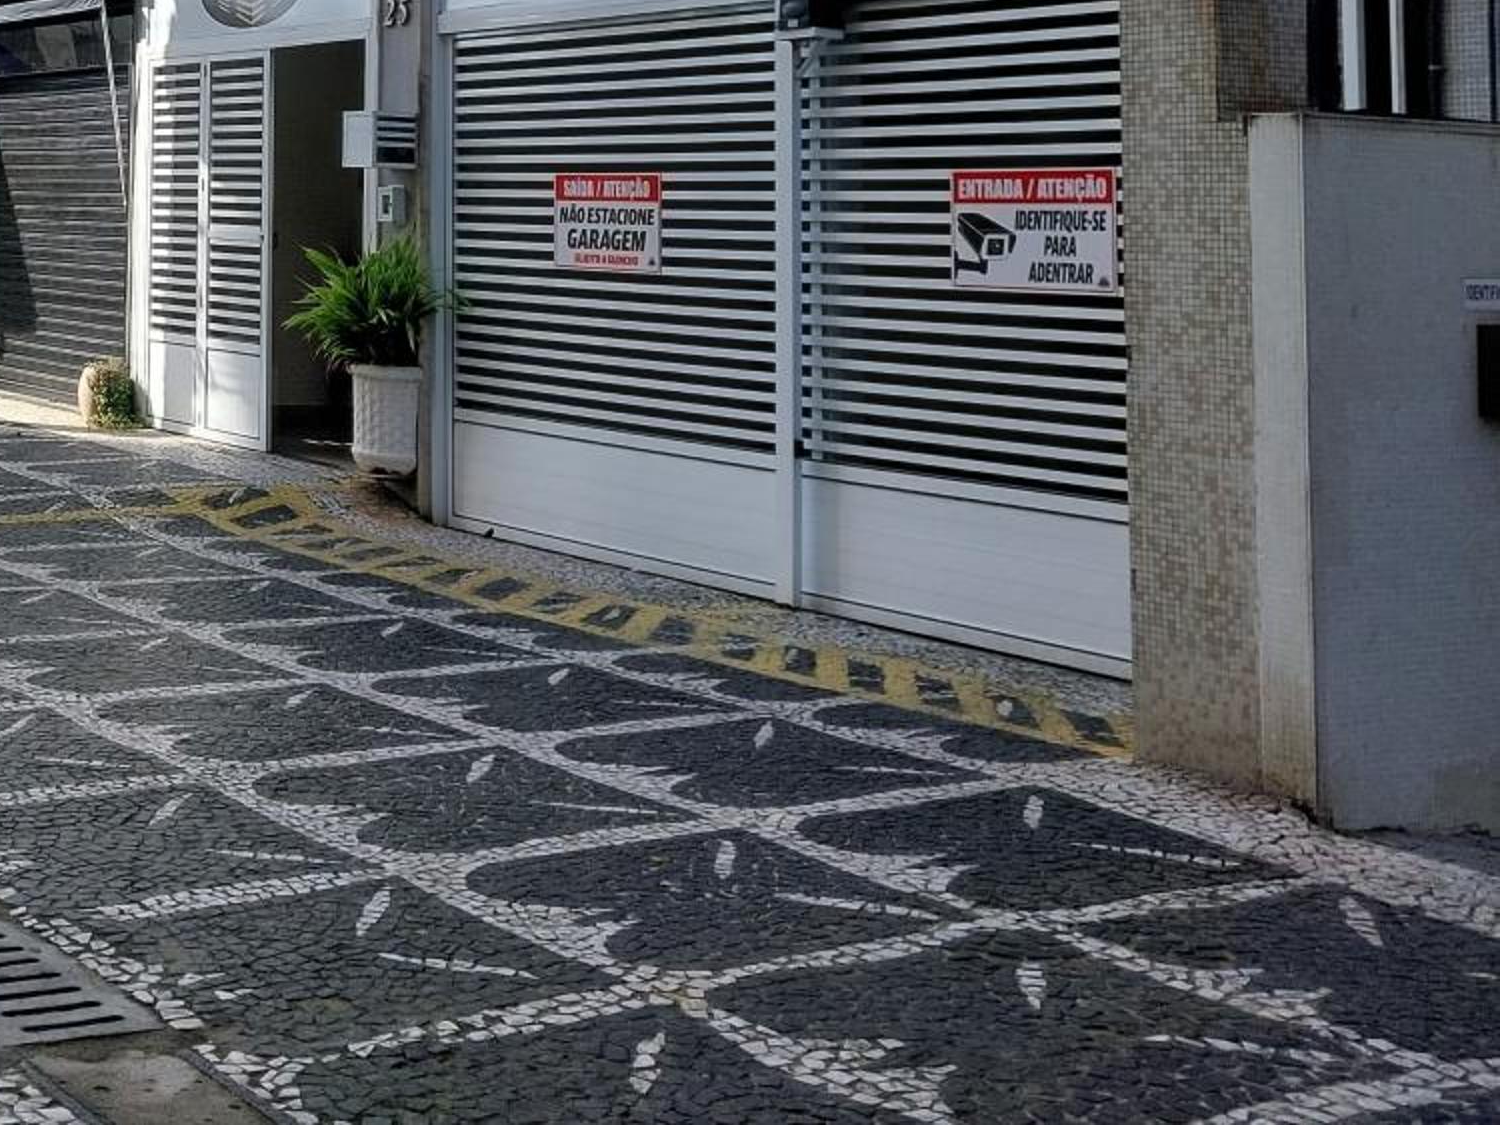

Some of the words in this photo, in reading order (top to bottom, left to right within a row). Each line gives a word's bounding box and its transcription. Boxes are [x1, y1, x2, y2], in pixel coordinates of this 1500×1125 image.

[603, 177, 650, 199] ATENÇÃO
[958, 178, 1023, 199] ENTRADA
[1037, 174, 1107, 202] ATENÇÃO
[560, 203, 585, 224] NÃO
[588, 208, 654, 225] ESTACIONE
[1015, 210, 1107, 233] IDENTIFIQUE-SE
[567, 228, 647, 252] GARAGEM
[1043, 236, 1077, 258] PARA
[1028, 262, 1094, 284] ADENTRAR
